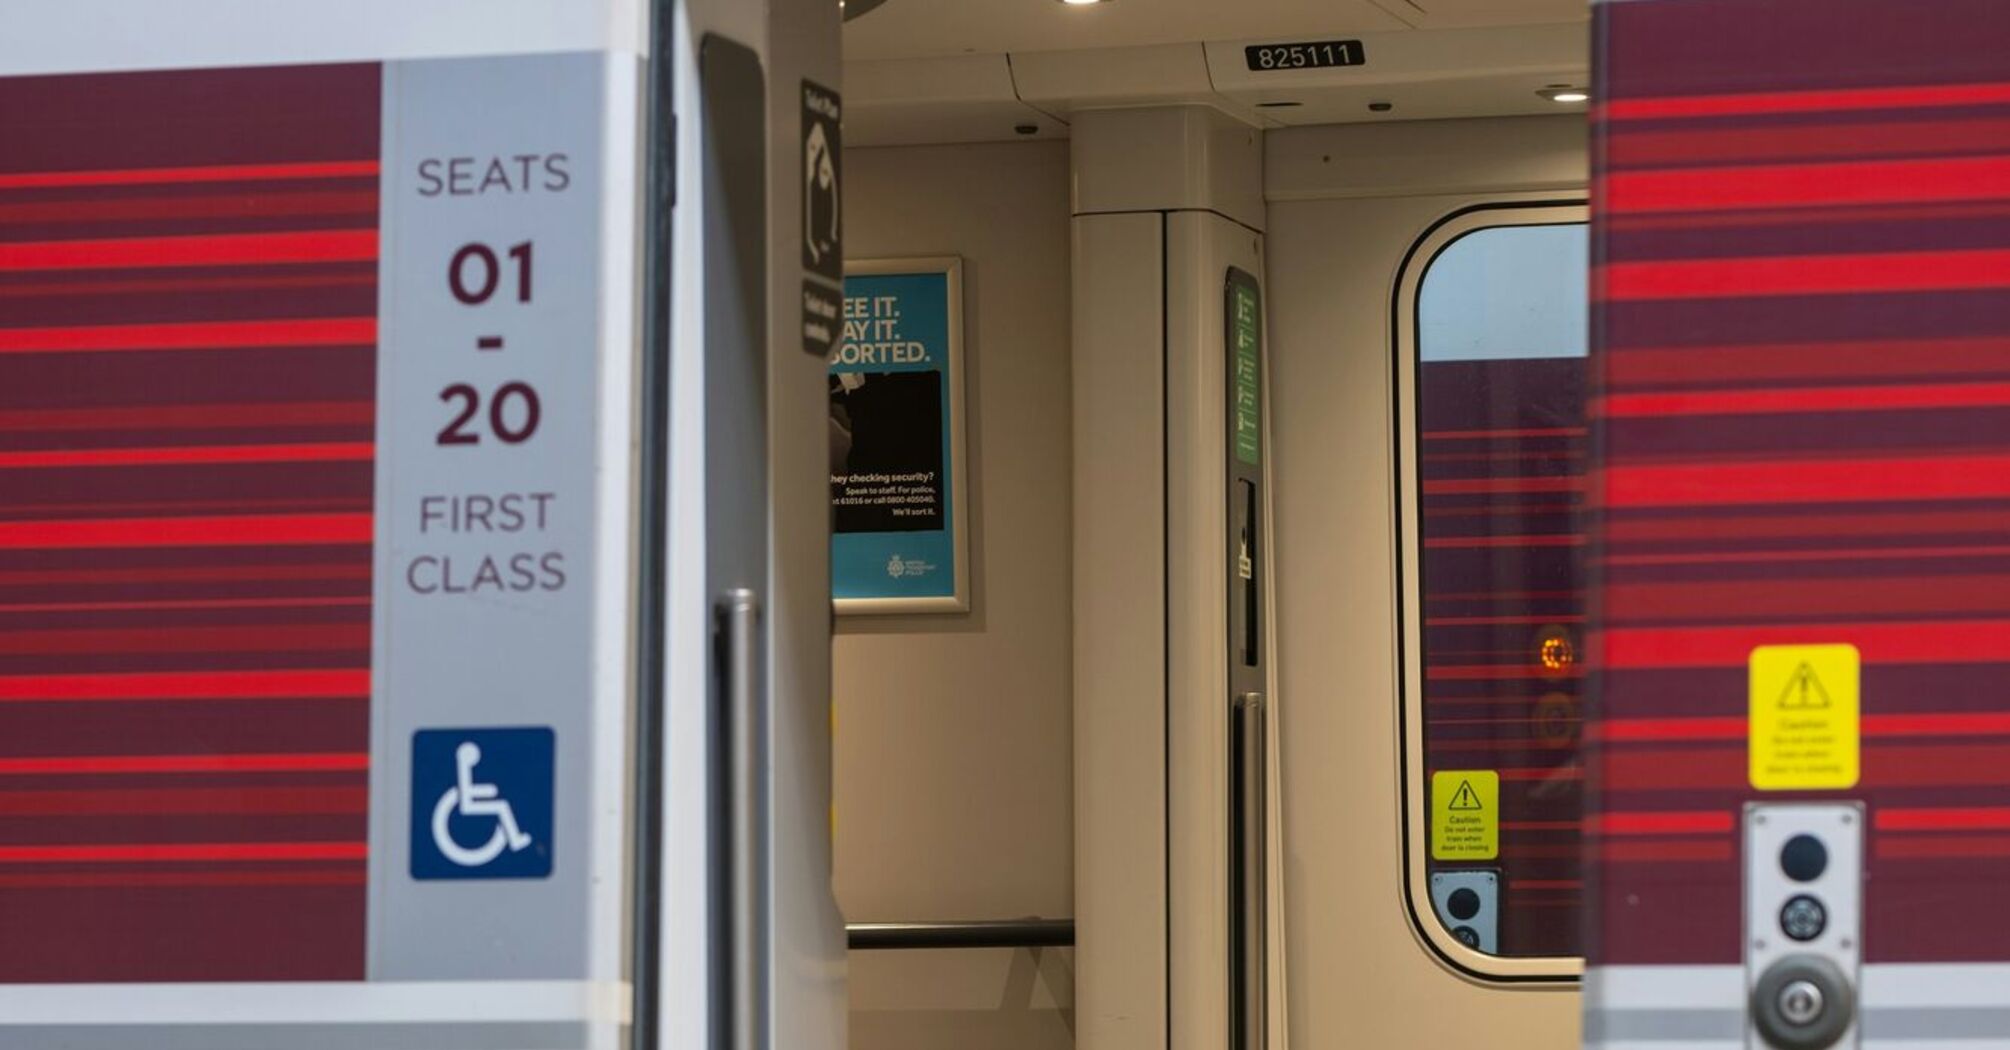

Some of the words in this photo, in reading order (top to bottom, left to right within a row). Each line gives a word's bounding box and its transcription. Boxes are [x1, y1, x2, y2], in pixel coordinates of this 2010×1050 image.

[1259, 44, 1350, 68] 825111
[417, 153, 570, 196] SEATS
[448, 239, 533, 306] 01
[874, 296, 900, 317] IT.
[874, 320, 900, 340] IT.
[436, 380, 541, 446] 20
[849, 474, 890, 483] checking
[891, 472, 934, 483] security?
[846, 487, 867, 495] Speak
[420, 492, 555, 533] FIRST
[407, 552, 566, 594] CLASS
[1449, 816, 1481, 824] Caution
